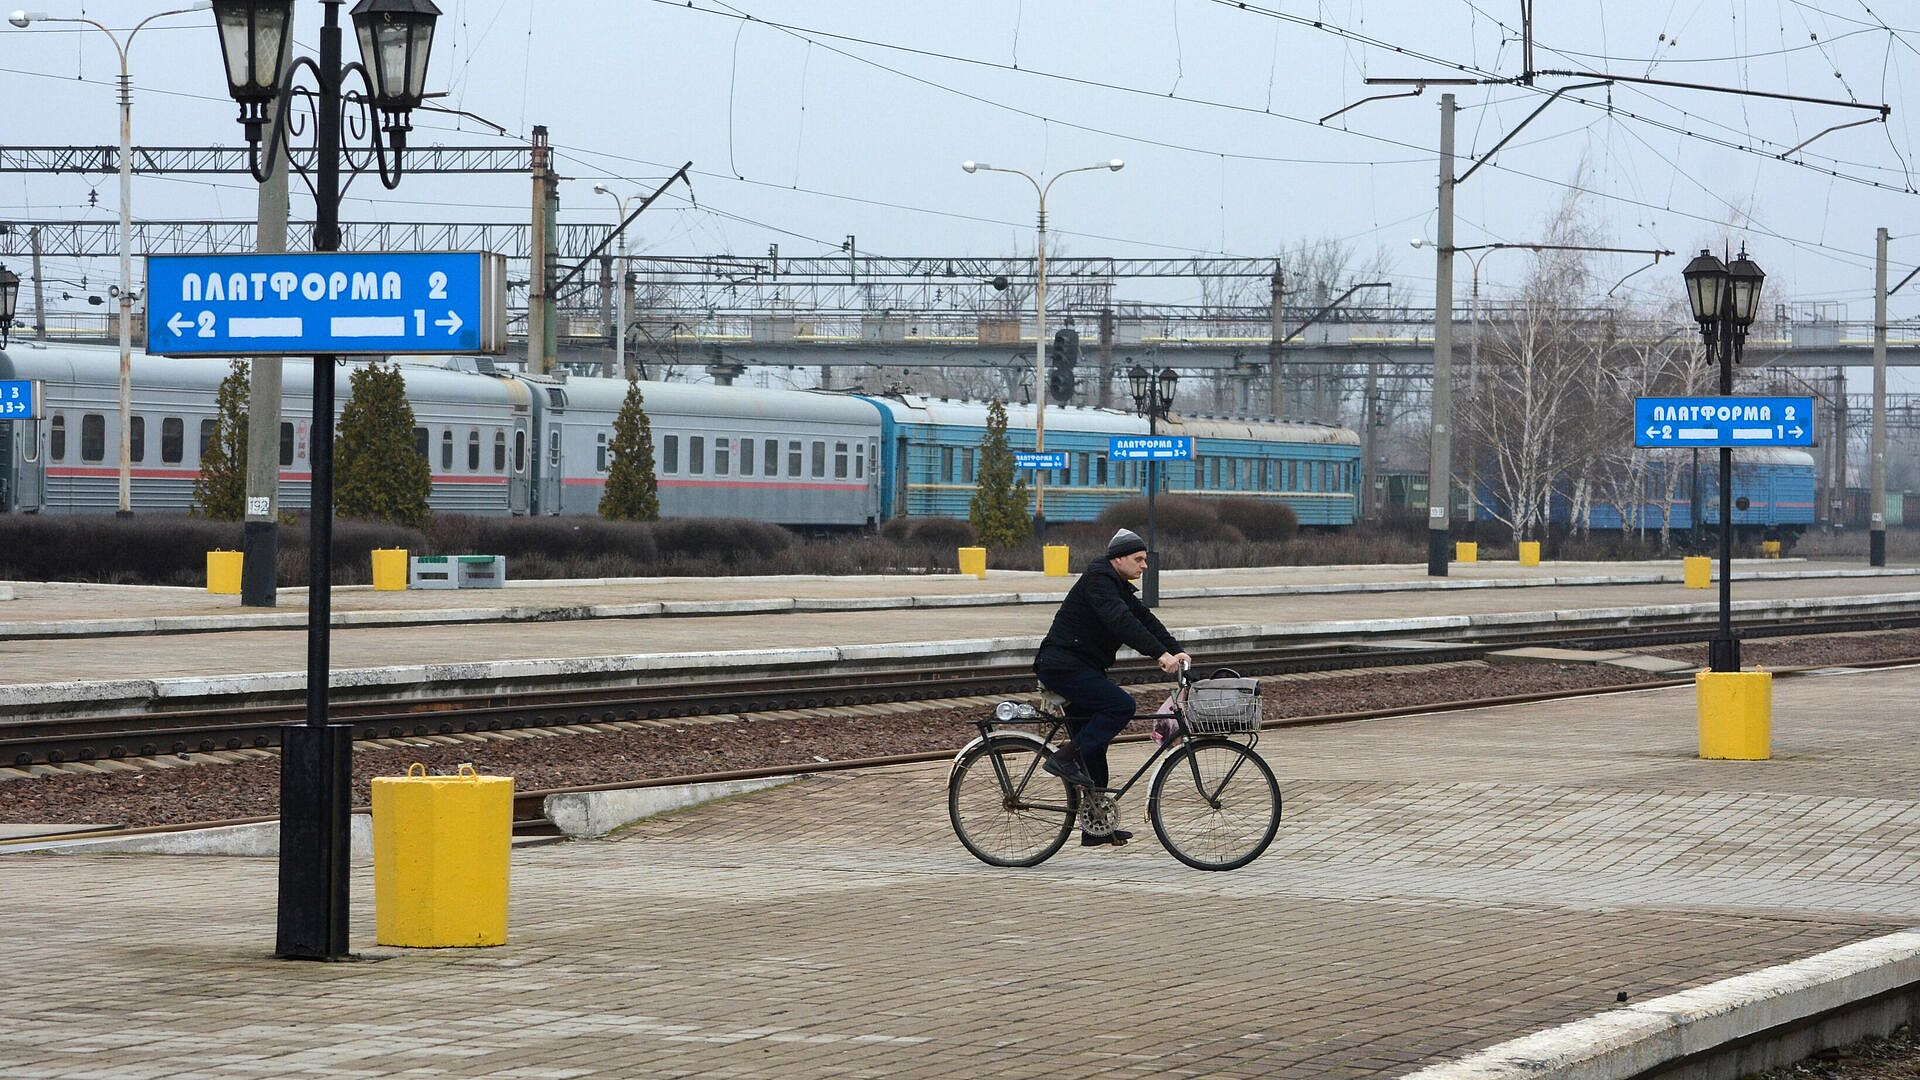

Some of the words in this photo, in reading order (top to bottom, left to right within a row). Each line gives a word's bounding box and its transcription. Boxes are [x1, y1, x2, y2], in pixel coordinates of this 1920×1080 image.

[182, 271, 401, 301] ПЛАТФОРМА
[428, 271, 448, 300] 2
[197, 310, 216, 338] 2
[413, 309, 426, 337] 1
[11, 387, 19, 399] 3
[6, 401, 14, 413] 3
[1653, 405, 1771, 421] ПЛАТФОРМА
[1784, 406, 1796, 421] 2
[1662, 425, 1673, 439] 2
[1776, 424, 1784, 439] 1
[1117, 440, 1172, 449] ПЛАТФОРМА
[1177, 440, 1184, 448] 3
